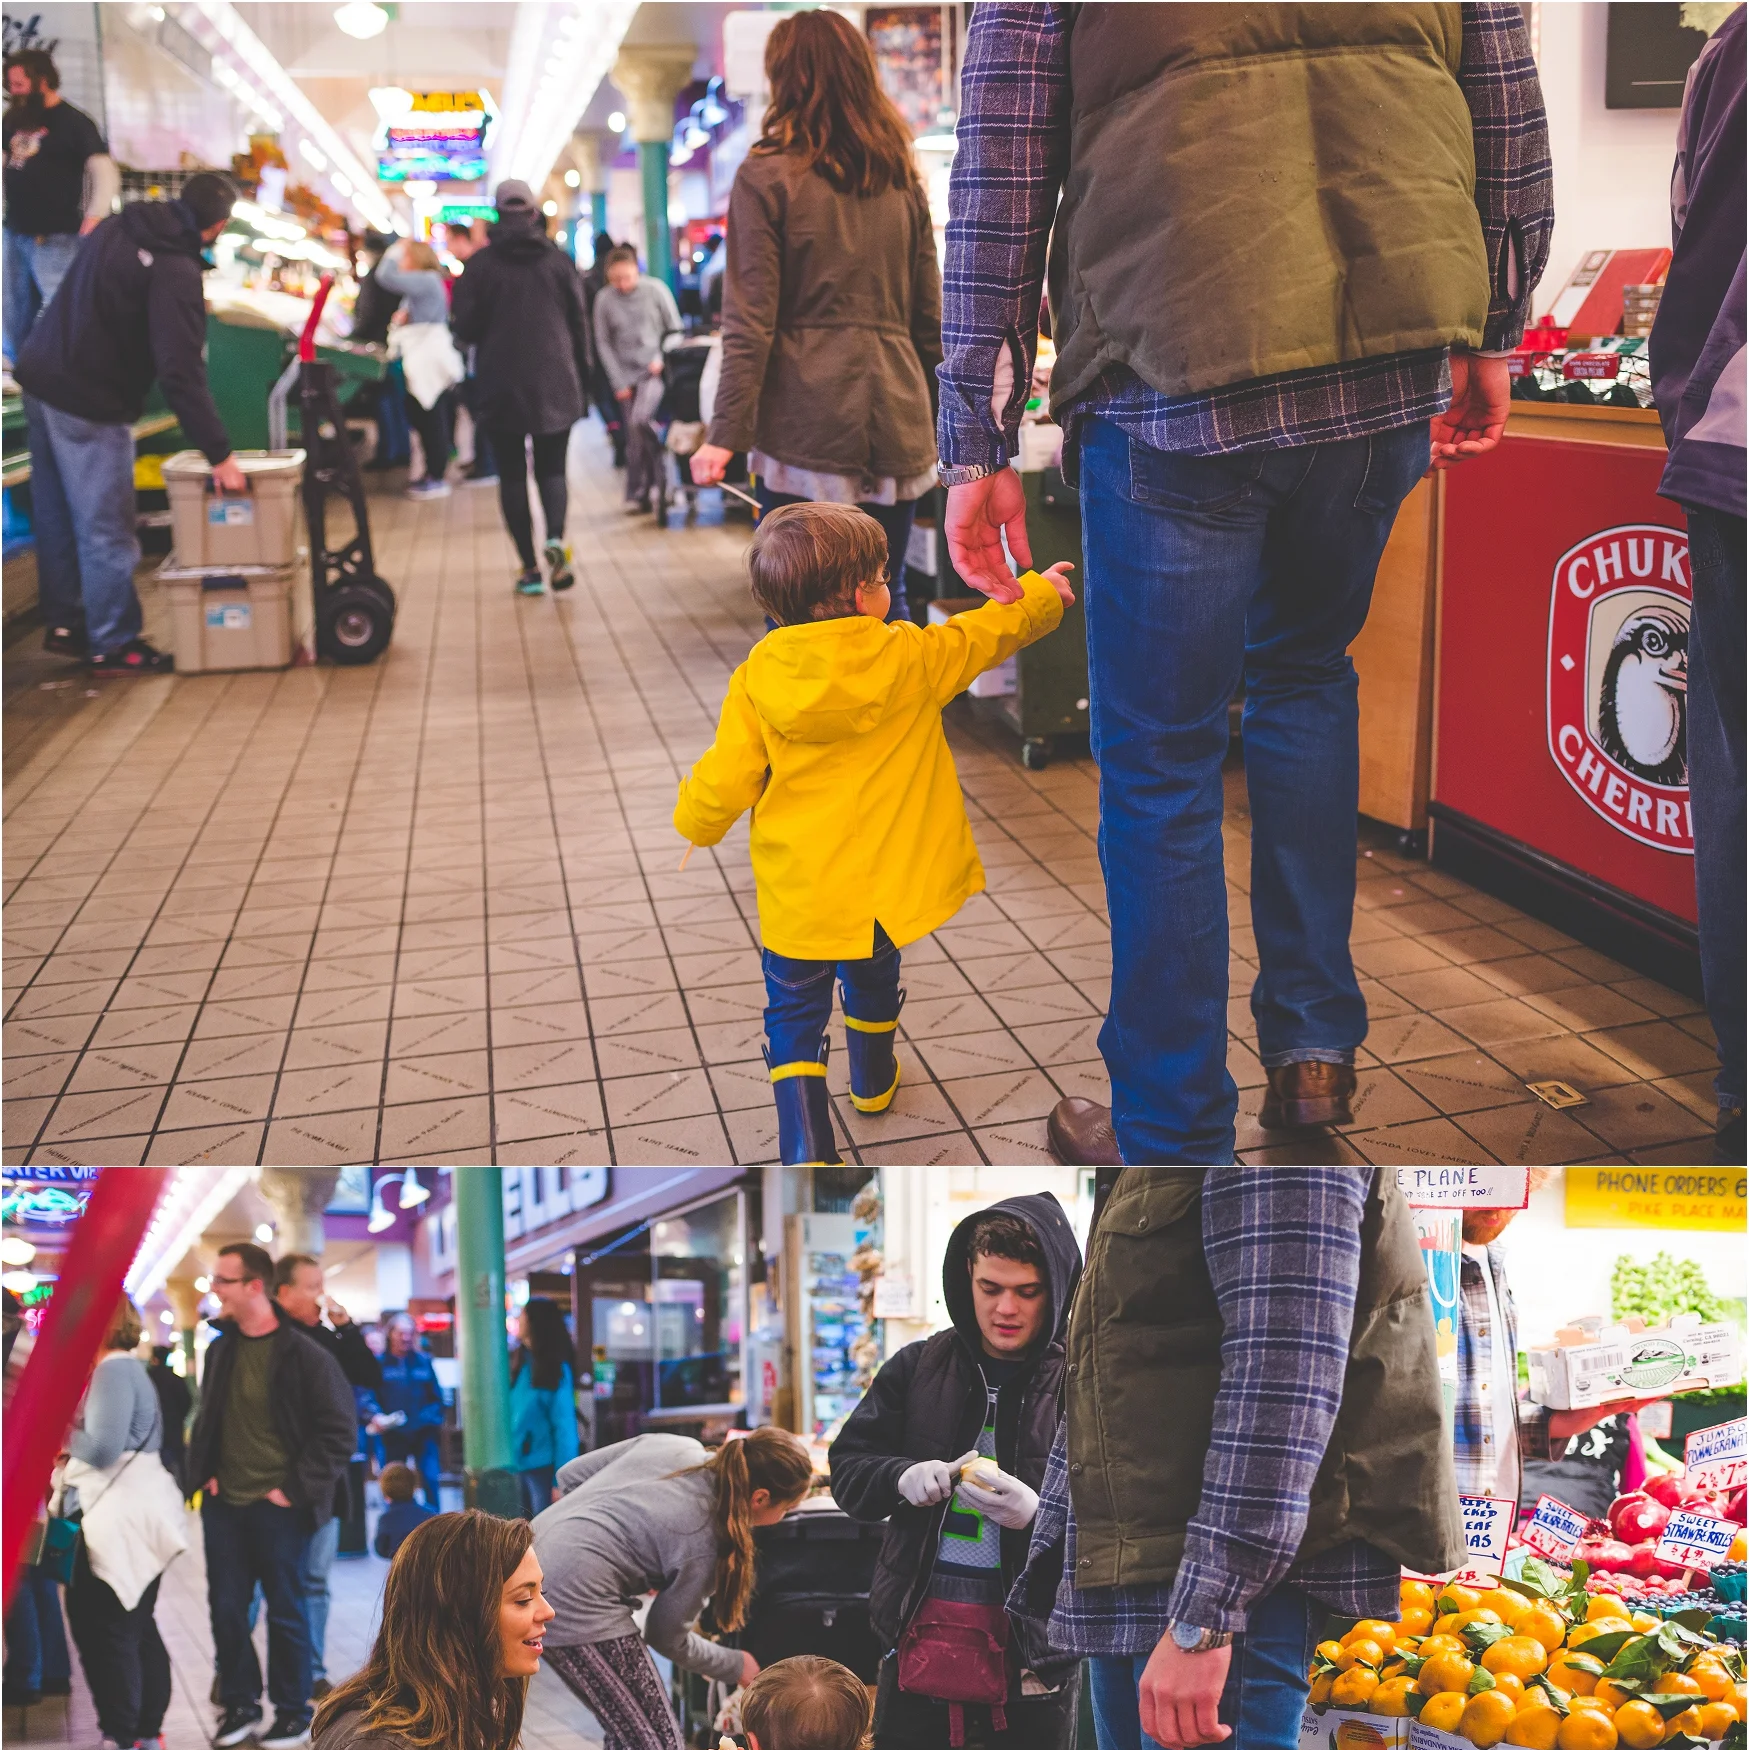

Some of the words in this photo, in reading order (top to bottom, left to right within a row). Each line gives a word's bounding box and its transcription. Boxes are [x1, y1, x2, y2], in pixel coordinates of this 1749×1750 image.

[989, 1133, 1013, 1144] CHRIS
[1362, 1137, 1402, 1150] NEVADA
[1406, 1146, 1436, 1158] LOVES
[1417, 1167, 1479, 1187] PLANE
[1597, 1172, 1657, 1194] PHONE
[1665, 1174, 1727, 1197] ORDERS
[1438, 1190, 1449, 1198] IT
[1453, 1190, 1467, 1198] OFF
[1628, 1203, 1663, 1217] PIKE
[1672, 1203, 1715, 1217] PLACE
[1697, 1423, 1746, 1446] JUMBO
[1546, 1501, 1573, 1519] SWEET
[1679, 1513, 1719, 1529] SWEET
[1663, 1522, 1735, 1548] STRAWBERRIES
